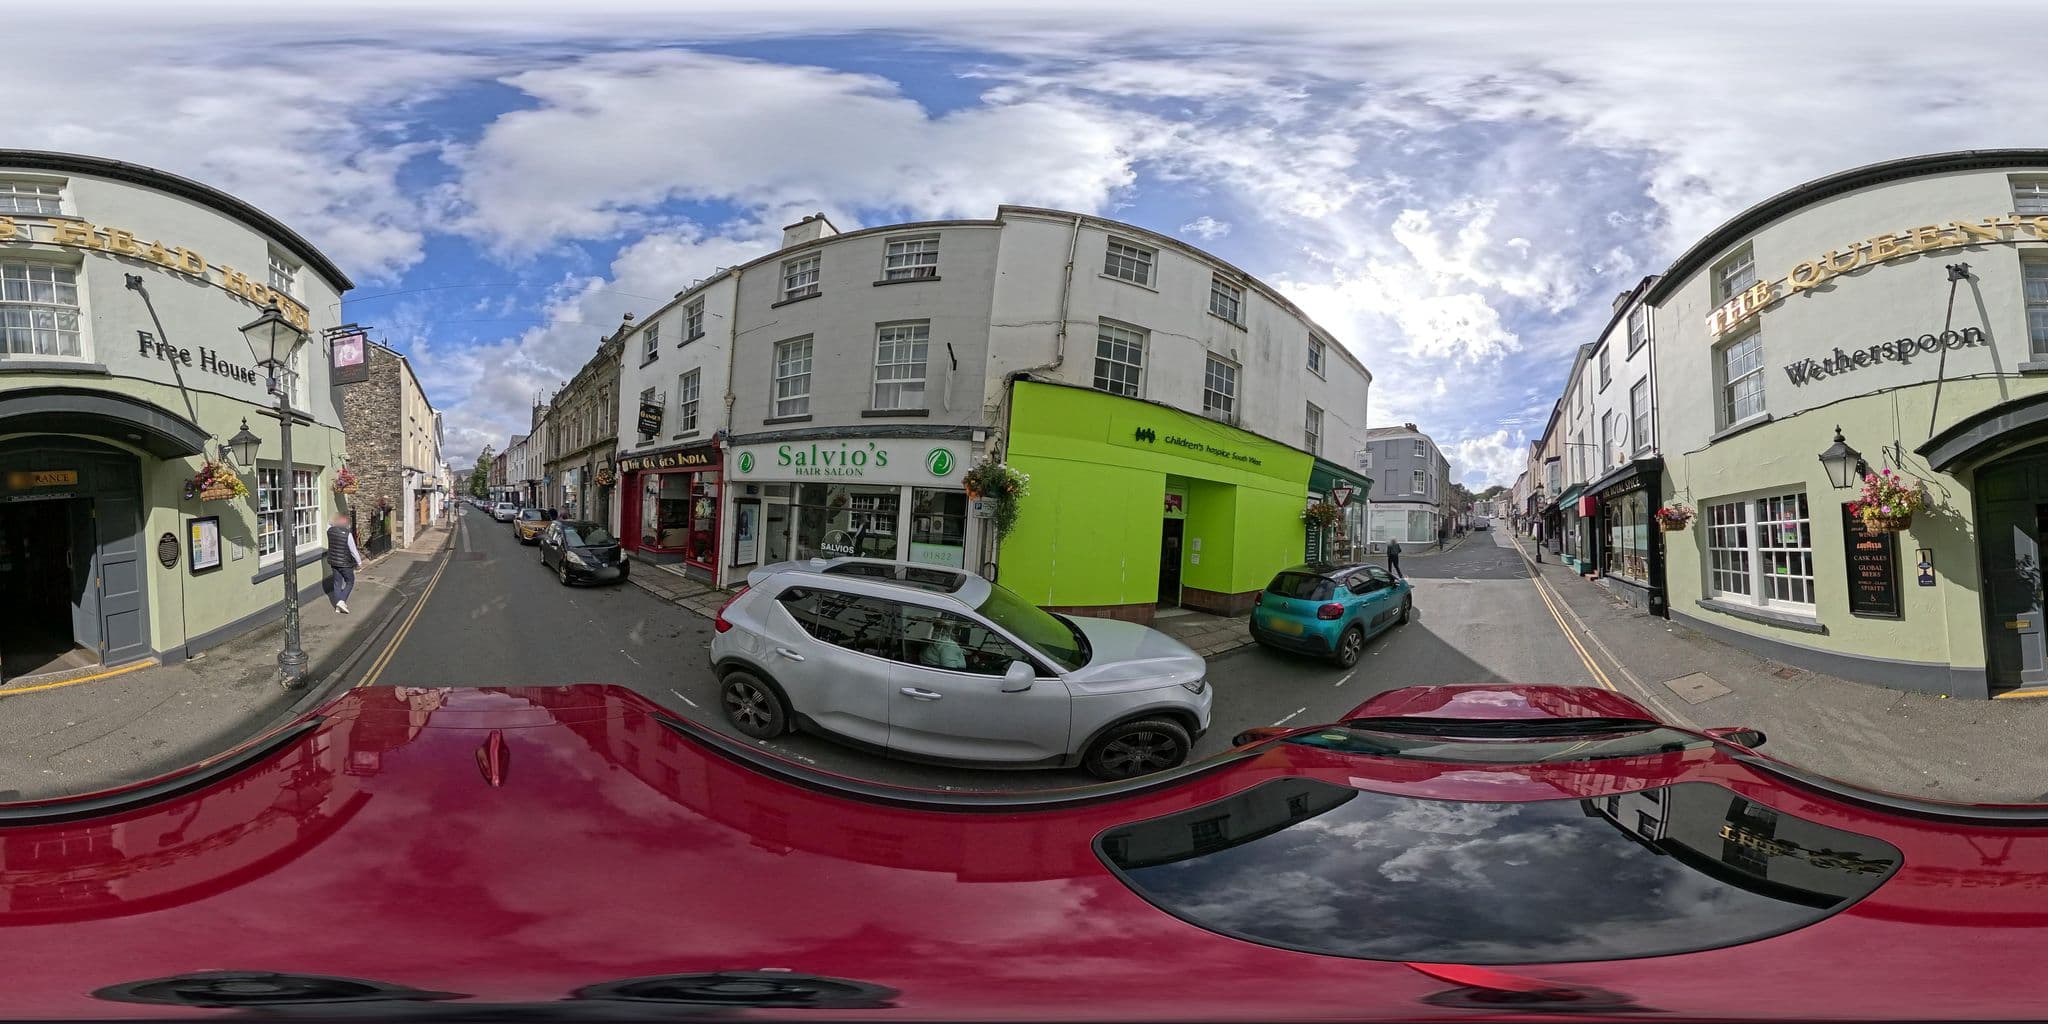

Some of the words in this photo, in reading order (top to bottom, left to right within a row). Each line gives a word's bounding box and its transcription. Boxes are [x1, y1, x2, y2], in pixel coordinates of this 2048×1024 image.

[48, 218, 208, 274] HEAD
[1705, 279, 1771, 336] THE
[137, 330, 191, 364] Free
[199, 346, 256, 384] House
[1784, 326, 1984, 385] Wetherspoon
[678, 453, 708, 465] INDIA
[778, 442, 888, 467] Salvio's
[1164, 435, 1204, 452] children's
[1206, 445, 1230, 459] hospice
[1231, 451, 1247, 462] South
[795, 467, 821, 476] HAIR
[824, 467, 863, 477] SALON
[821, 542, 855, 554] SALVIOS
[923, 551, 952, 561] 01822
